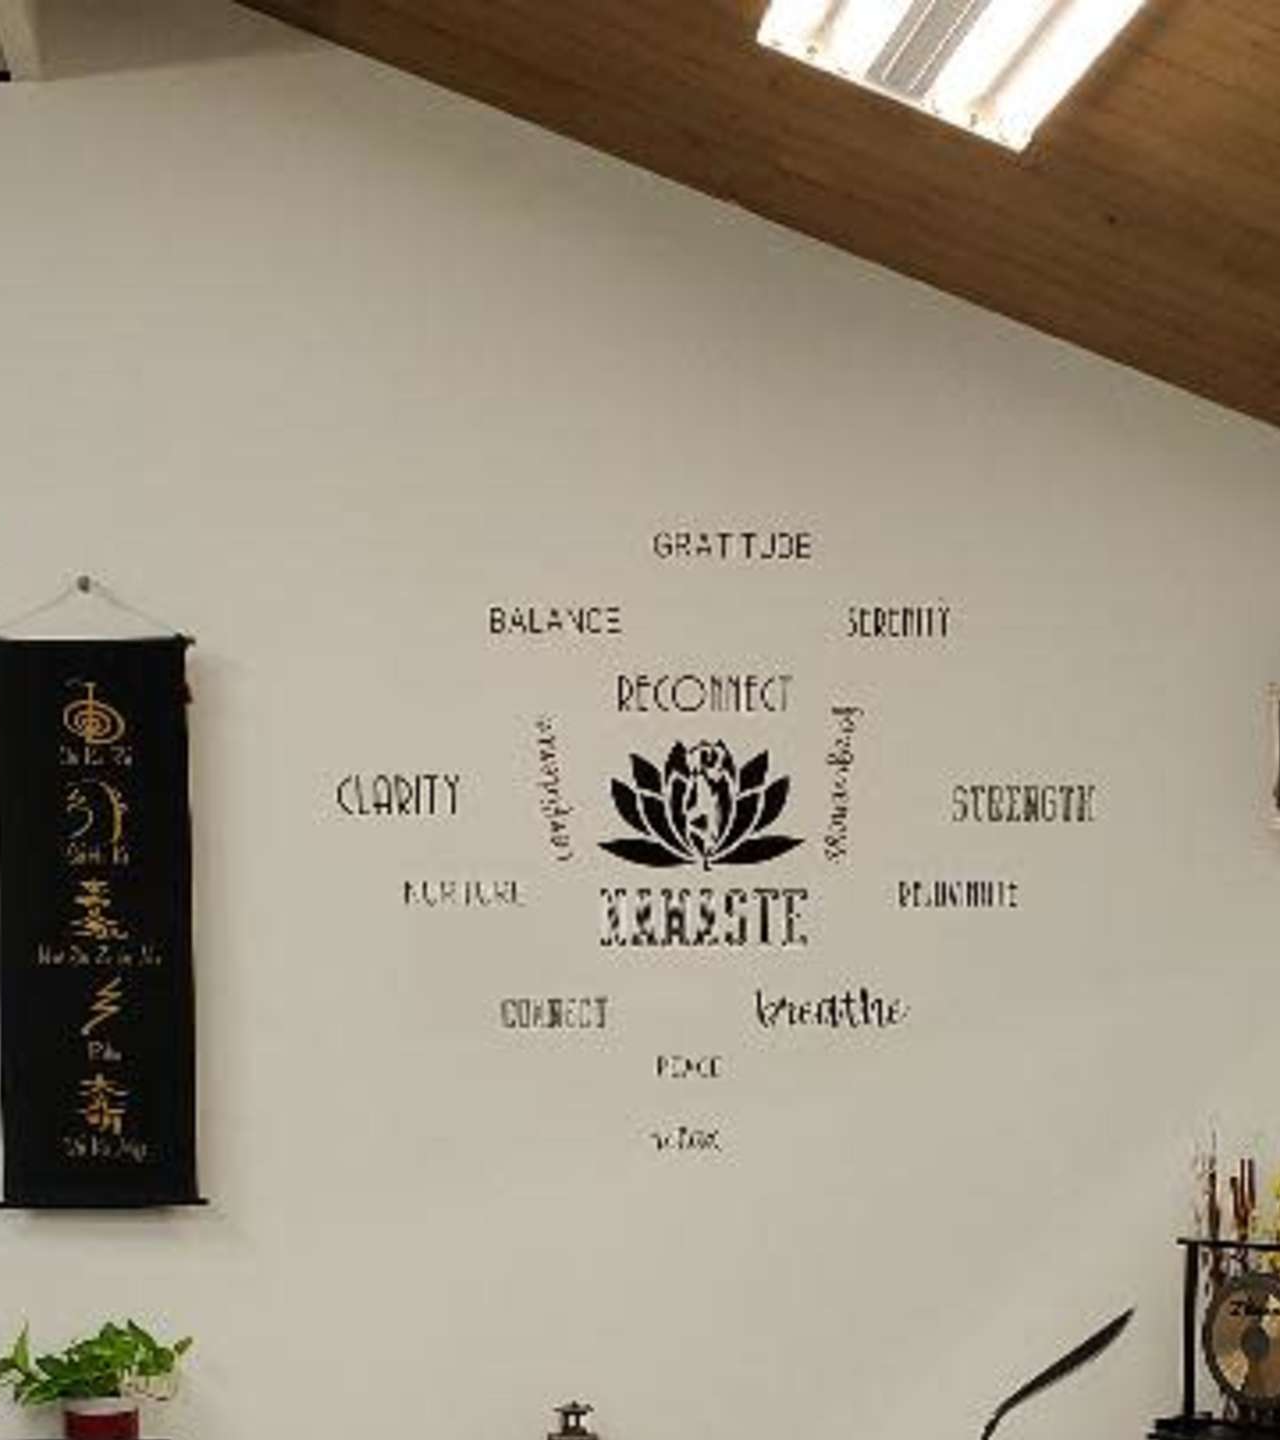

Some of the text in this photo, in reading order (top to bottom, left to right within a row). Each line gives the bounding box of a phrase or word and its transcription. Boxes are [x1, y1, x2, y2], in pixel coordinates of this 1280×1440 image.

[652, 531, 812, 560] GRATTUDE
[489, 606, 623, 635] BALANCE
[846, 606, 951, 638] SERENITY
[617, 673, 793, 713] RECONNECT
[336, 773, 461, 816] CLARITY
[952, 784, 1096, 823] STRENGTH
[599, 886, 809, 948] NAMASTE
[500, 996, 609, 1029] CONNECT
[754, 986, 911, 1030] breathe
